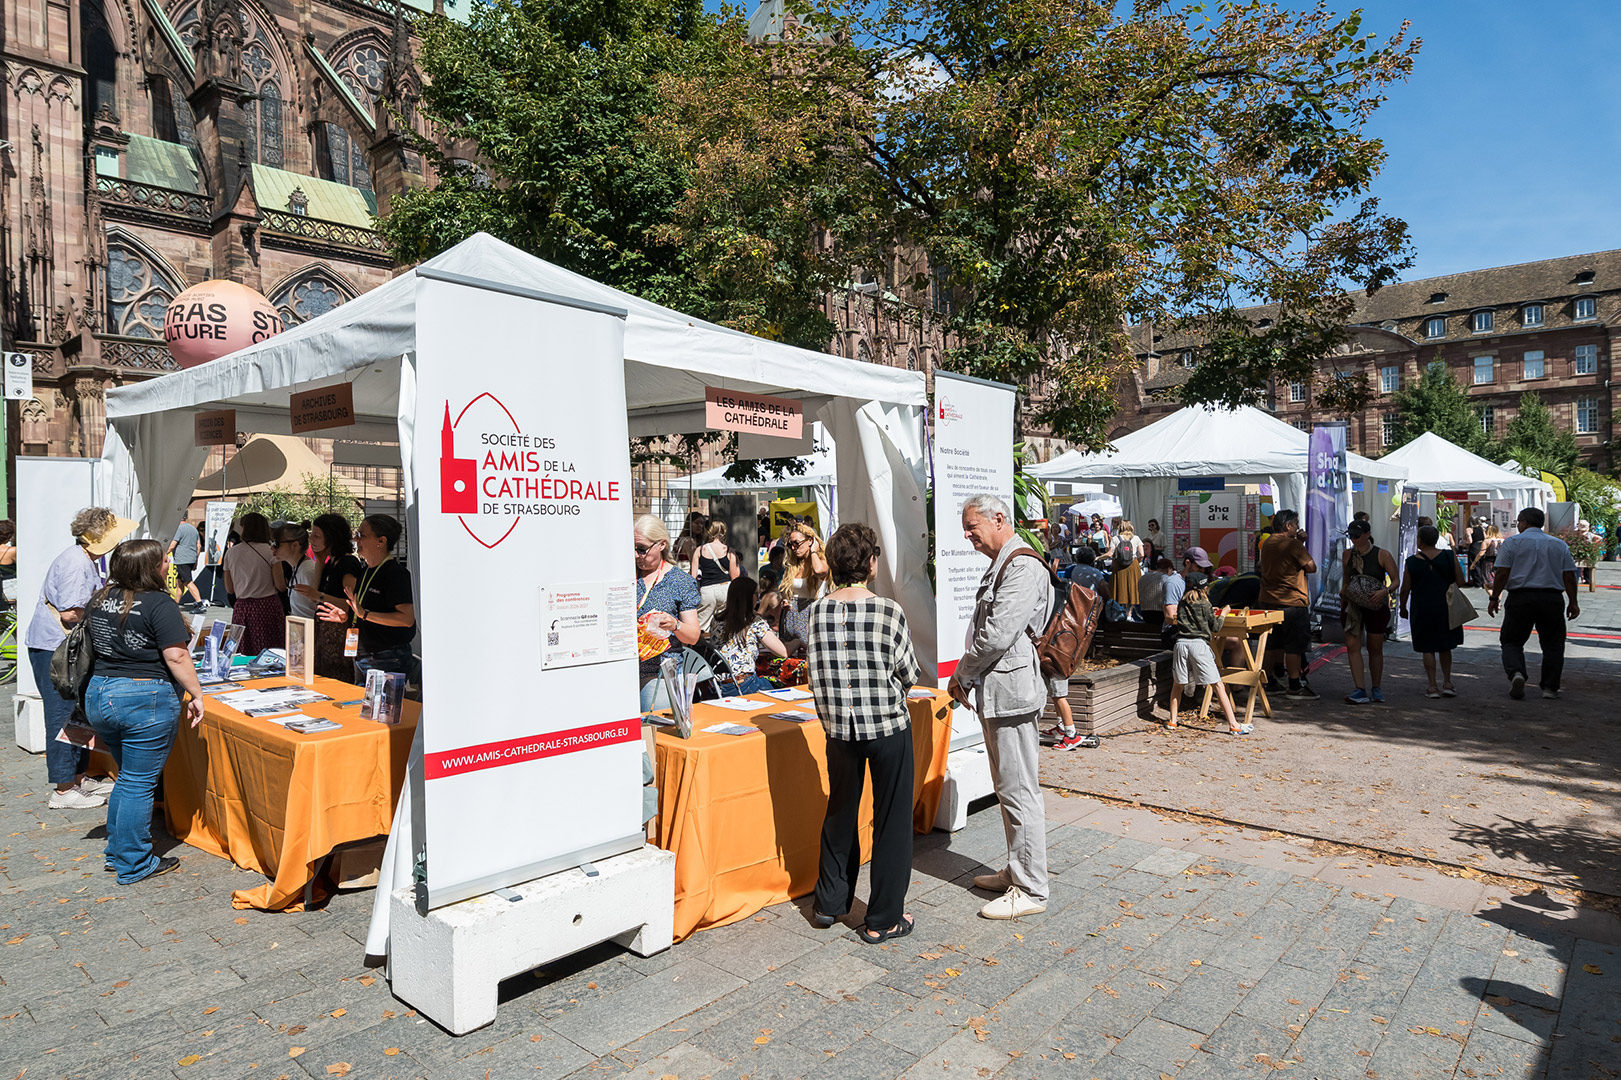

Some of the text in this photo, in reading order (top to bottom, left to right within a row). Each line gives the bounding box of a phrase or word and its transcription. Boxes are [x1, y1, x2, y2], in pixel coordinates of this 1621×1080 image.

[302, 394, 336, 410] ARCHIVES
[716, 396, 795, 417] LES AMIS DE LA
[294, 407, 348, 426] DE STRASBOURG
[724, 412, 788, 430] CATHÉDRALE
[481, 432, 556, 449] SOCIÉTÉ DES
[482, 449, 576, 472] AMIS DE LA
[1317, 452, 1339, 469] Sha
[483, 474, 620, 501] CATHÉDRALE
[483, 503, 581, 515] DE STRASBOURG
[442, 727, 628, 769] WWW.AMIS-CATHEDRALE-STRASBOURG.EU
